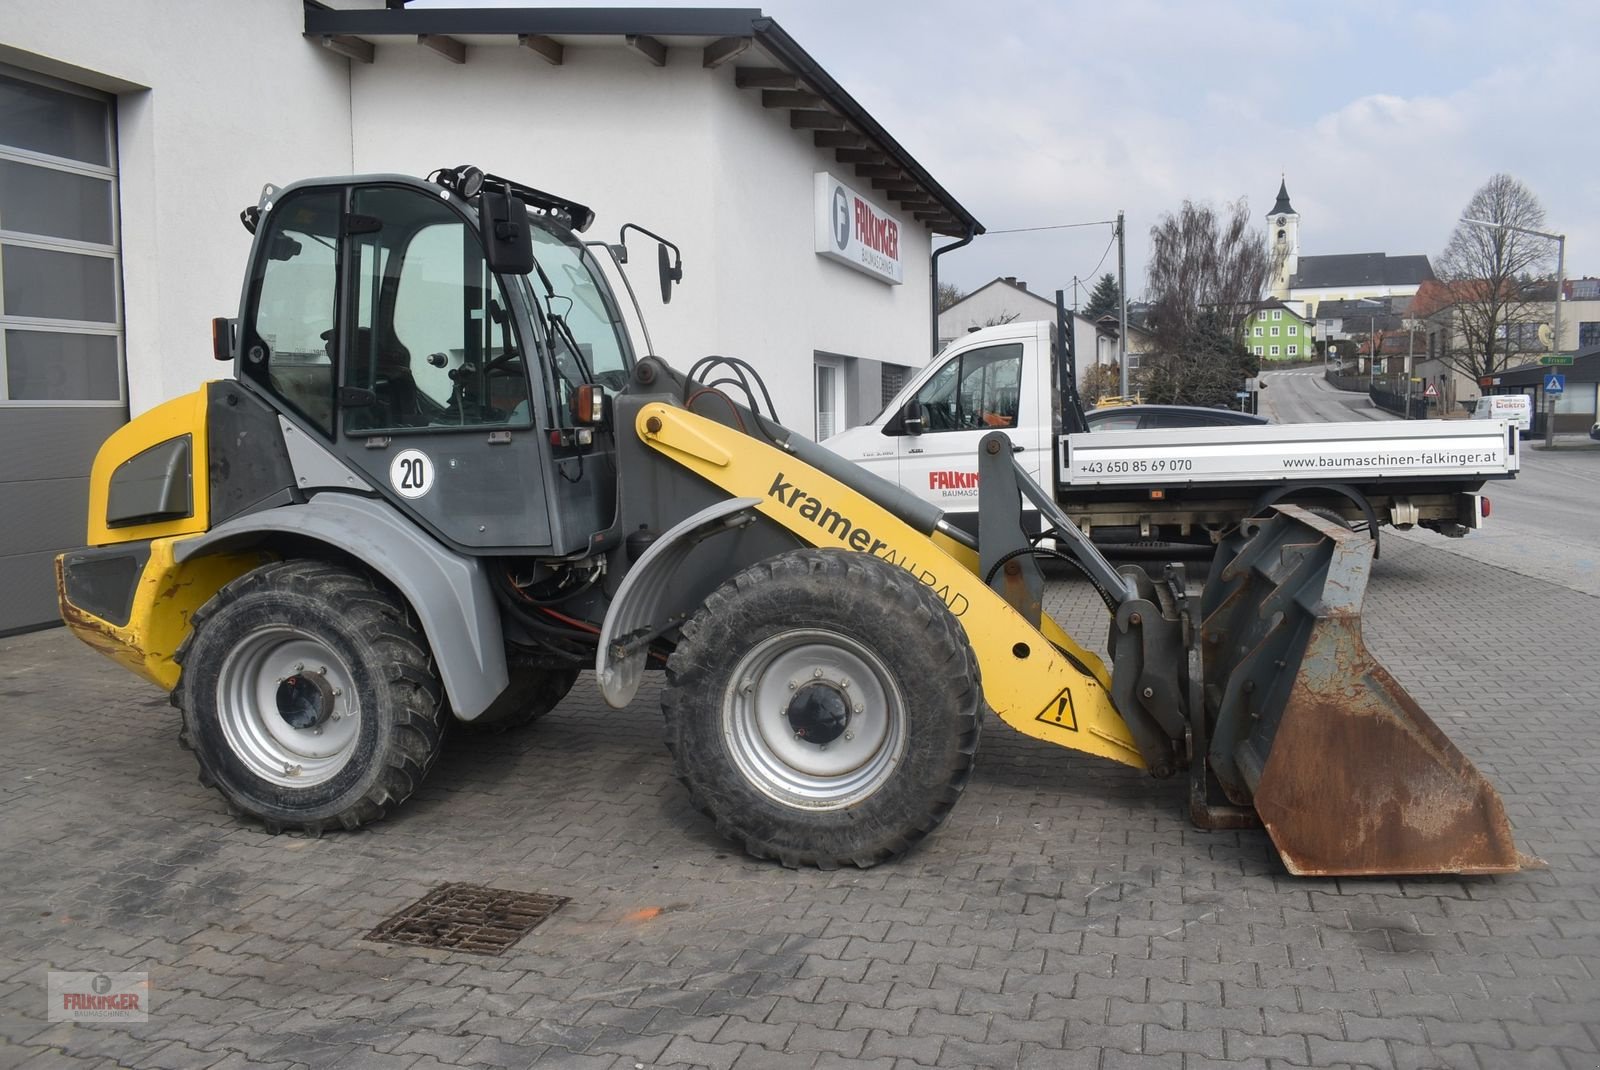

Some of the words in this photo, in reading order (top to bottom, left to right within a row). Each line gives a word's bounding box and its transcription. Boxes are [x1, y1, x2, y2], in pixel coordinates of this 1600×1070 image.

[854, 196, 899, 262] FALKINGER
[1496, 399, 1526, 409] Elektro
[1081, 462, 1103, 473] +43
[1106, 461, 1129, 473] 650
[1132, 460, 1148, 472] 85
[1151, 459, 1166, 472] 69
[1169, 459, 1192, 471] 070
[1282, 452, 1497, 468] www.baumaschinen-falkinger.at
[400, 458, 424, 489] 20
[929, 471, 979, 490] FALKIN
